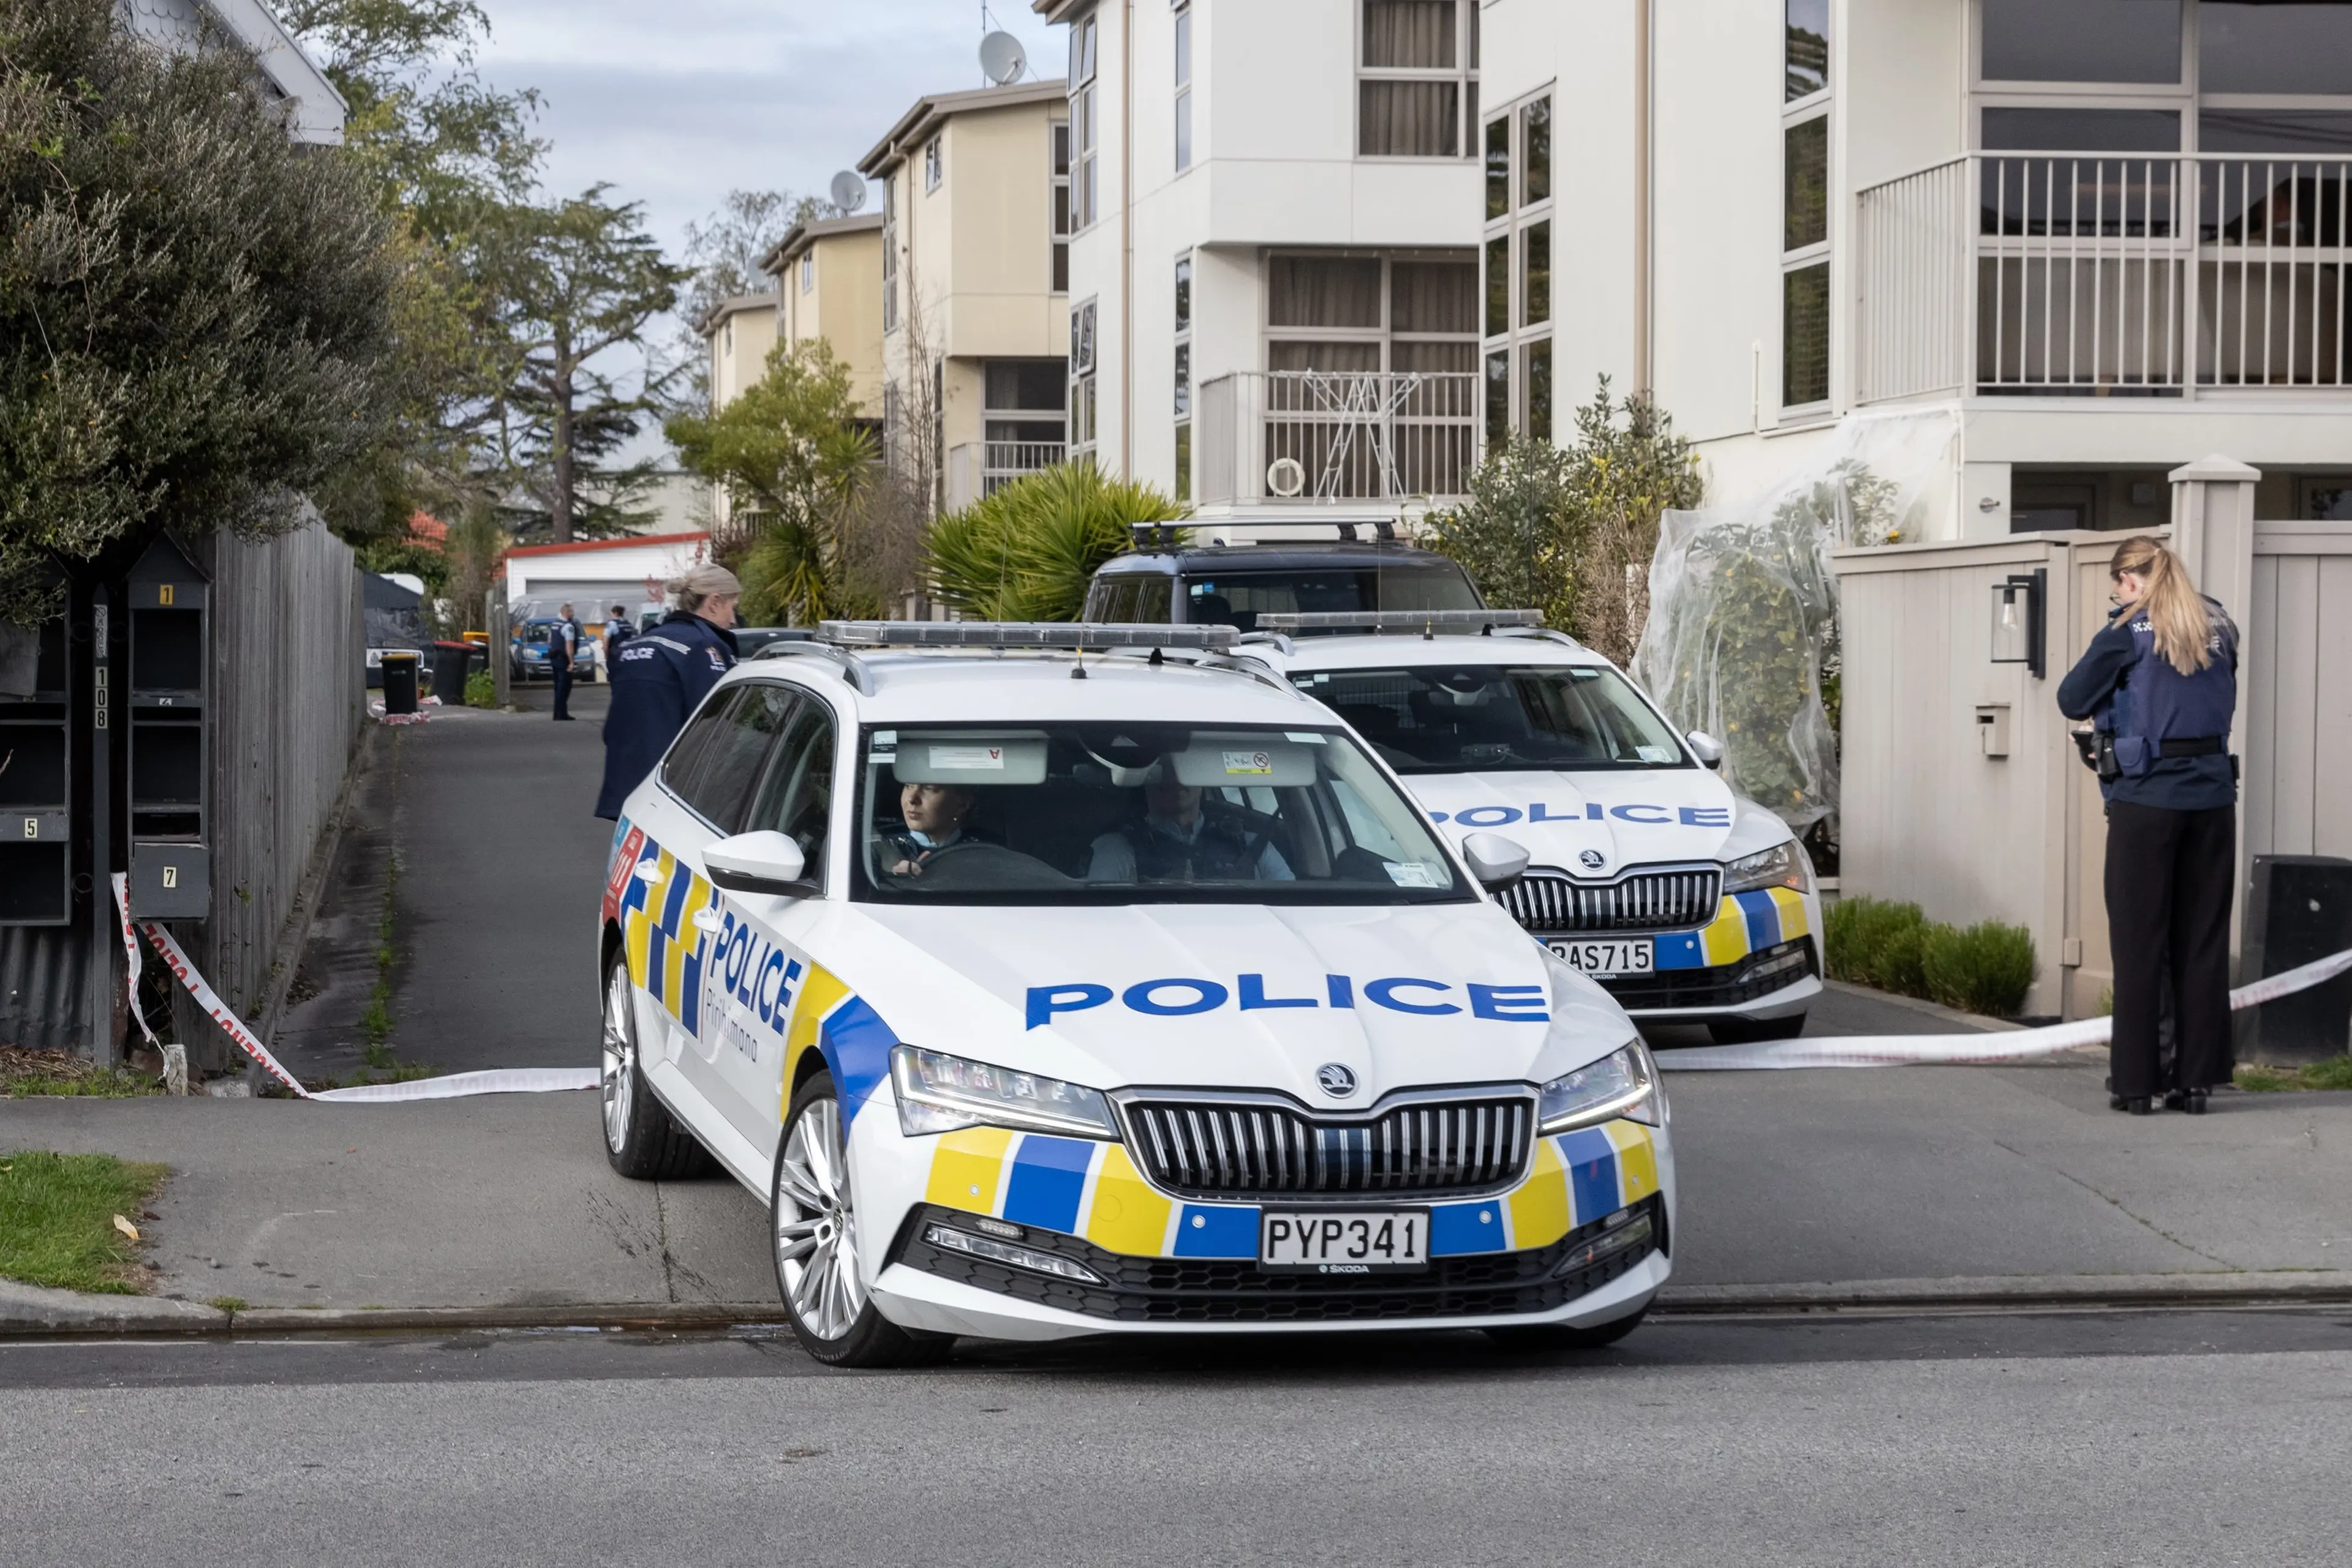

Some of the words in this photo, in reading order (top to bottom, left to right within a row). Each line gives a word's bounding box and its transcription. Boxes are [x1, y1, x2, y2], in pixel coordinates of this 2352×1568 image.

[163, 587, 170, 603] 1
[619, 647, 655, 662] POLICE
[27, 820, 35, 836] 5
[166, 869, 175, 885] 7
[611, 851, 633, 888] 111
[710, 910, 802, 1037] POLICE
[1025, 973, 1551, 1031] POLICE
[1267, 1219, 1415, 1259] PYP341
